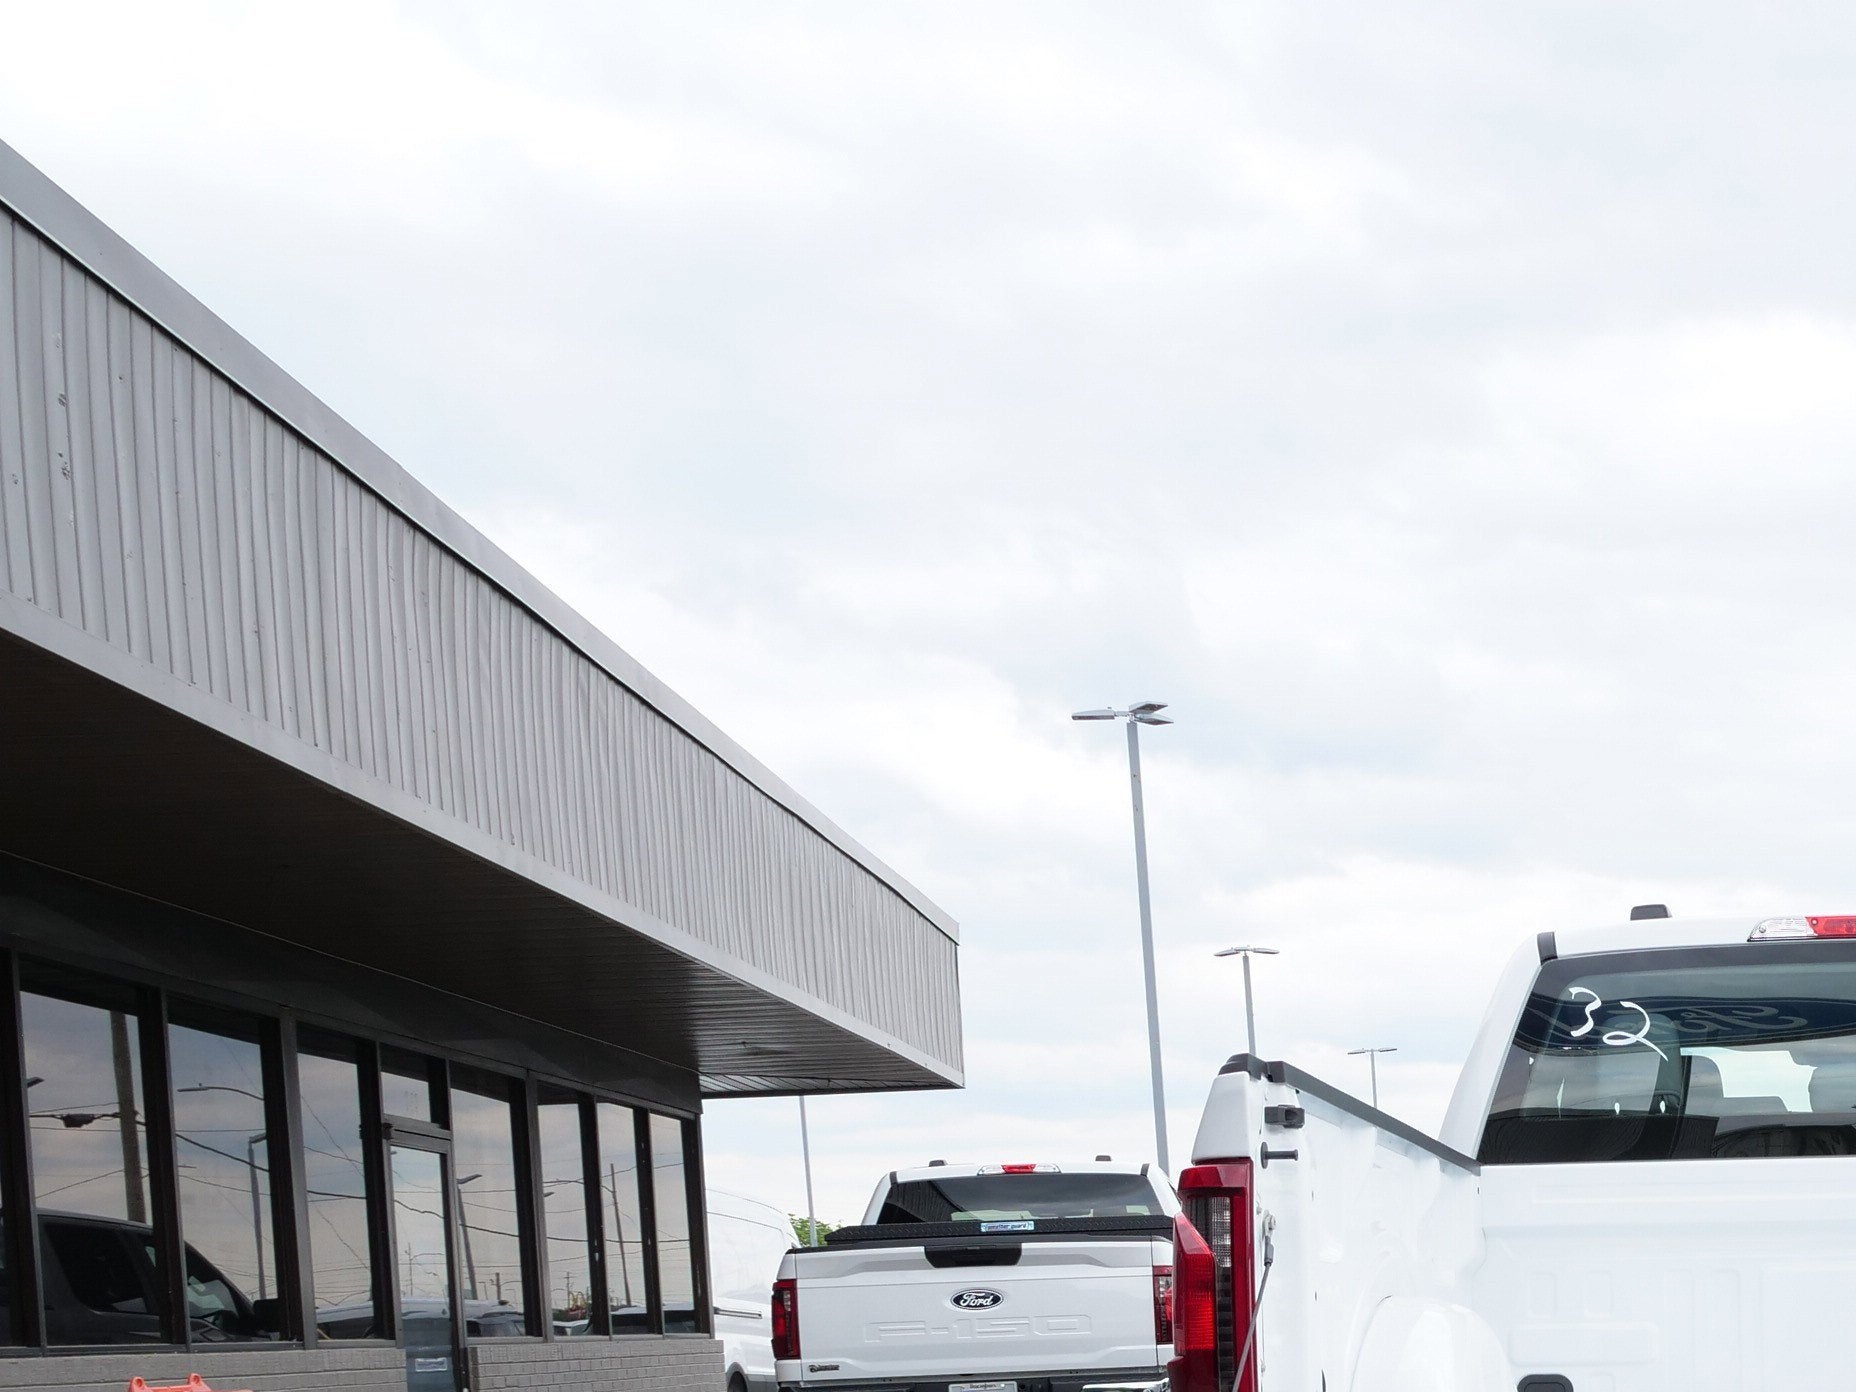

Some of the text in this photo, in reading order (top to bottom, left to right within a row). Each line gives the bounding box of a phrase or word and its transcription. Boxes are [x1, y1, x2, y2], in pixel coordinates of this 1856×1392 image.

[1568, 986, 1669, 1062] 32
[960, 1292, 994, 1307] Ford
[864, 1314, 1092, 1343] F-150
